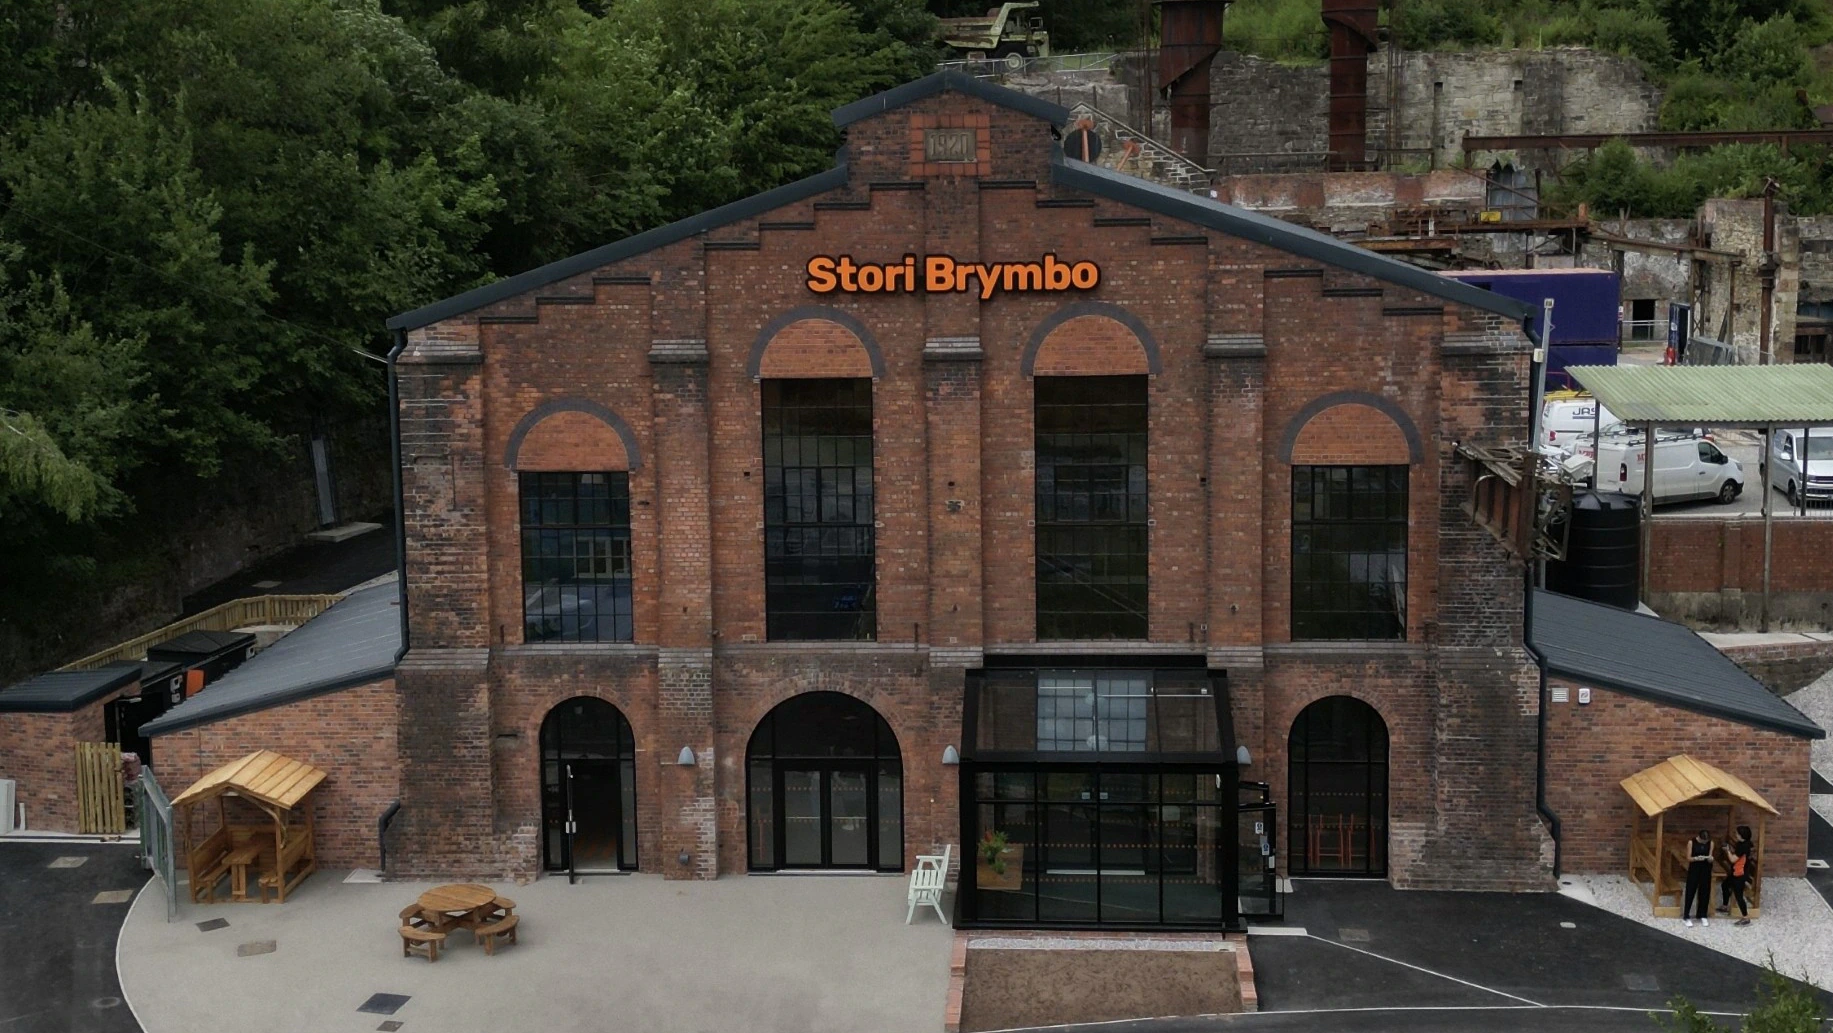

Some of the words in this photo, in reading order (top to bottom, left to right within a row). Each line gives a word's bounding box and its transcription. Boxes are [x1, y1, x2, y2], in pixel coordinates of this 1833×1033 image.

[929, 133, 969, 157] 1920
[807, 256, 915, 292] Stori
[925, 255, 1098, 299] Brymbo
